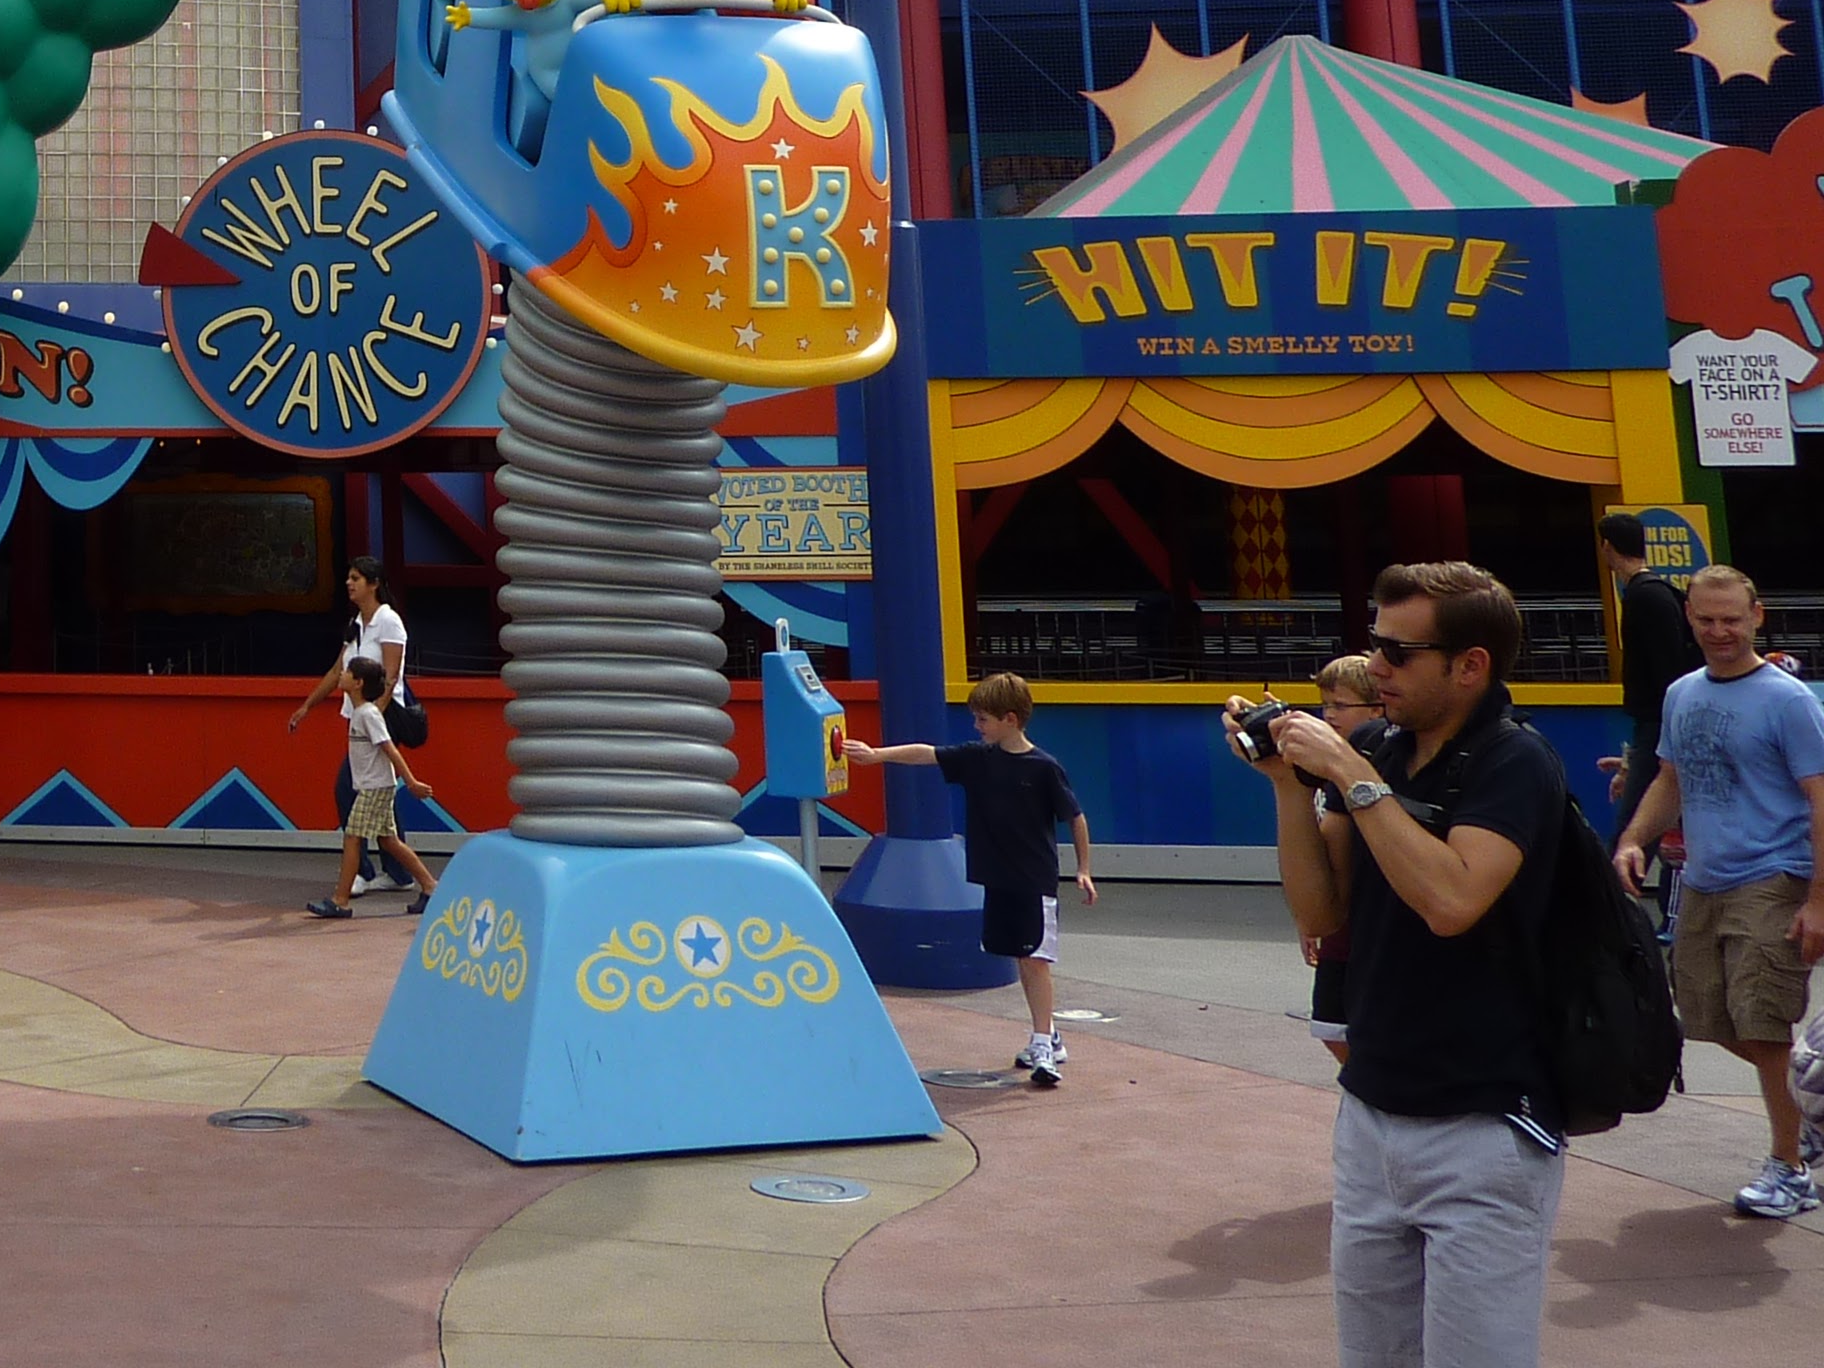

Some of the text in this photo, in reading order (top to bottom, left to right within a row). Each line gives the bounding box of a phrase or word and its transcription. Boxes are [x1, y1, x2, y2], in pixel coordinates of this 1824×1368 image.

[202, 157, 439, 273] WHEEL
[743, 164, 856, 309] K
[1032, 230, 1508, 323] HIT IT!
[290, 263, 356, 315] OF
[1137, 334, 1415, 356] WIN A SMELLY TOY!
[197, 294, 462, 432] CHANCE
[1696, 354, 1779, 367] WANT YOUR
[1699, 368, 1780, 381] FACE ON A
[1700, 384, 1780, 401] T-SHIRT?
[1731, 412, 1754, 426] GO
[1704, 427, 1783, 439] SOMEWHERE
[1728, 441, 1763, 453] ELSE!
[716, 474, 870, 505] VOTED BOOTH
[764, 498, 820, 512] OF THE
[720, 511, 871, 553] YEAR
[1659, 526, 1690, 542] FOR
[1644, 544, 1692, 567] IDS!
